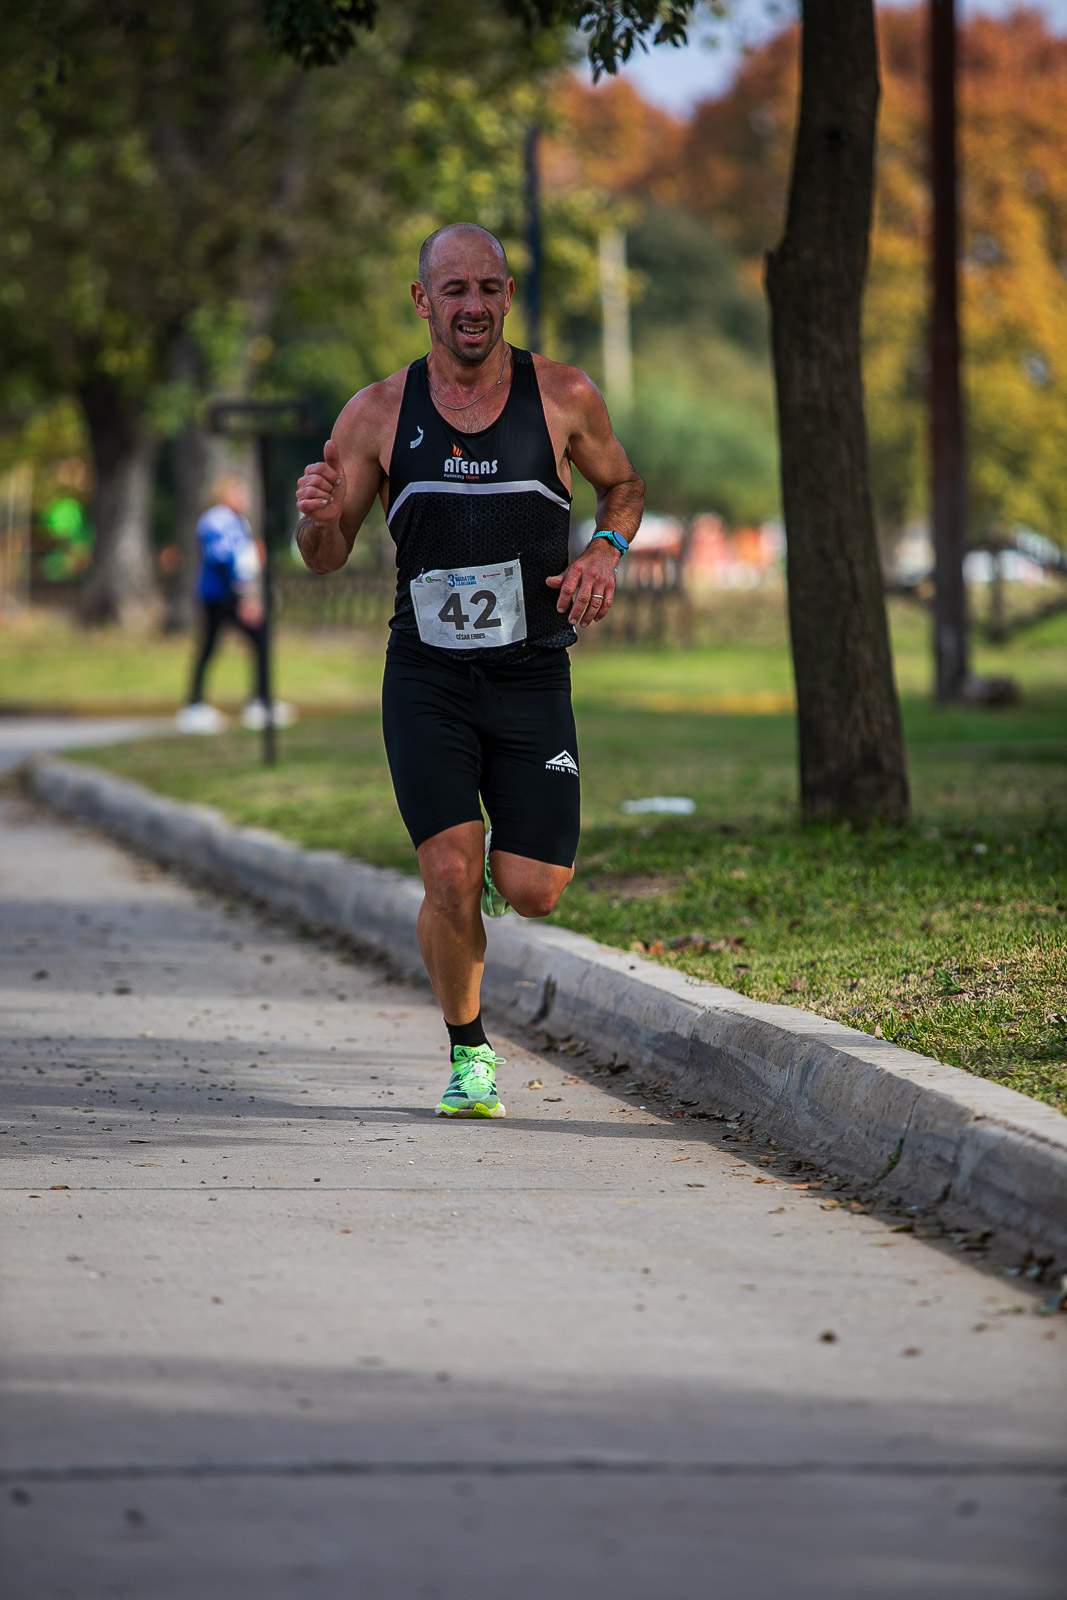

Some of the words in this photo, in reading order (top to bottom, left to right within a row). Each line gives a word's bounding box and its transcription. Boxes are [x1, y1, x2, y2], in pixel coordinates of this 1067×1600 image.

[444, 456, 498, 474] ATENAS
[438, 590, 502, 630] 42
[545, 764, 565, 772] NIKE
